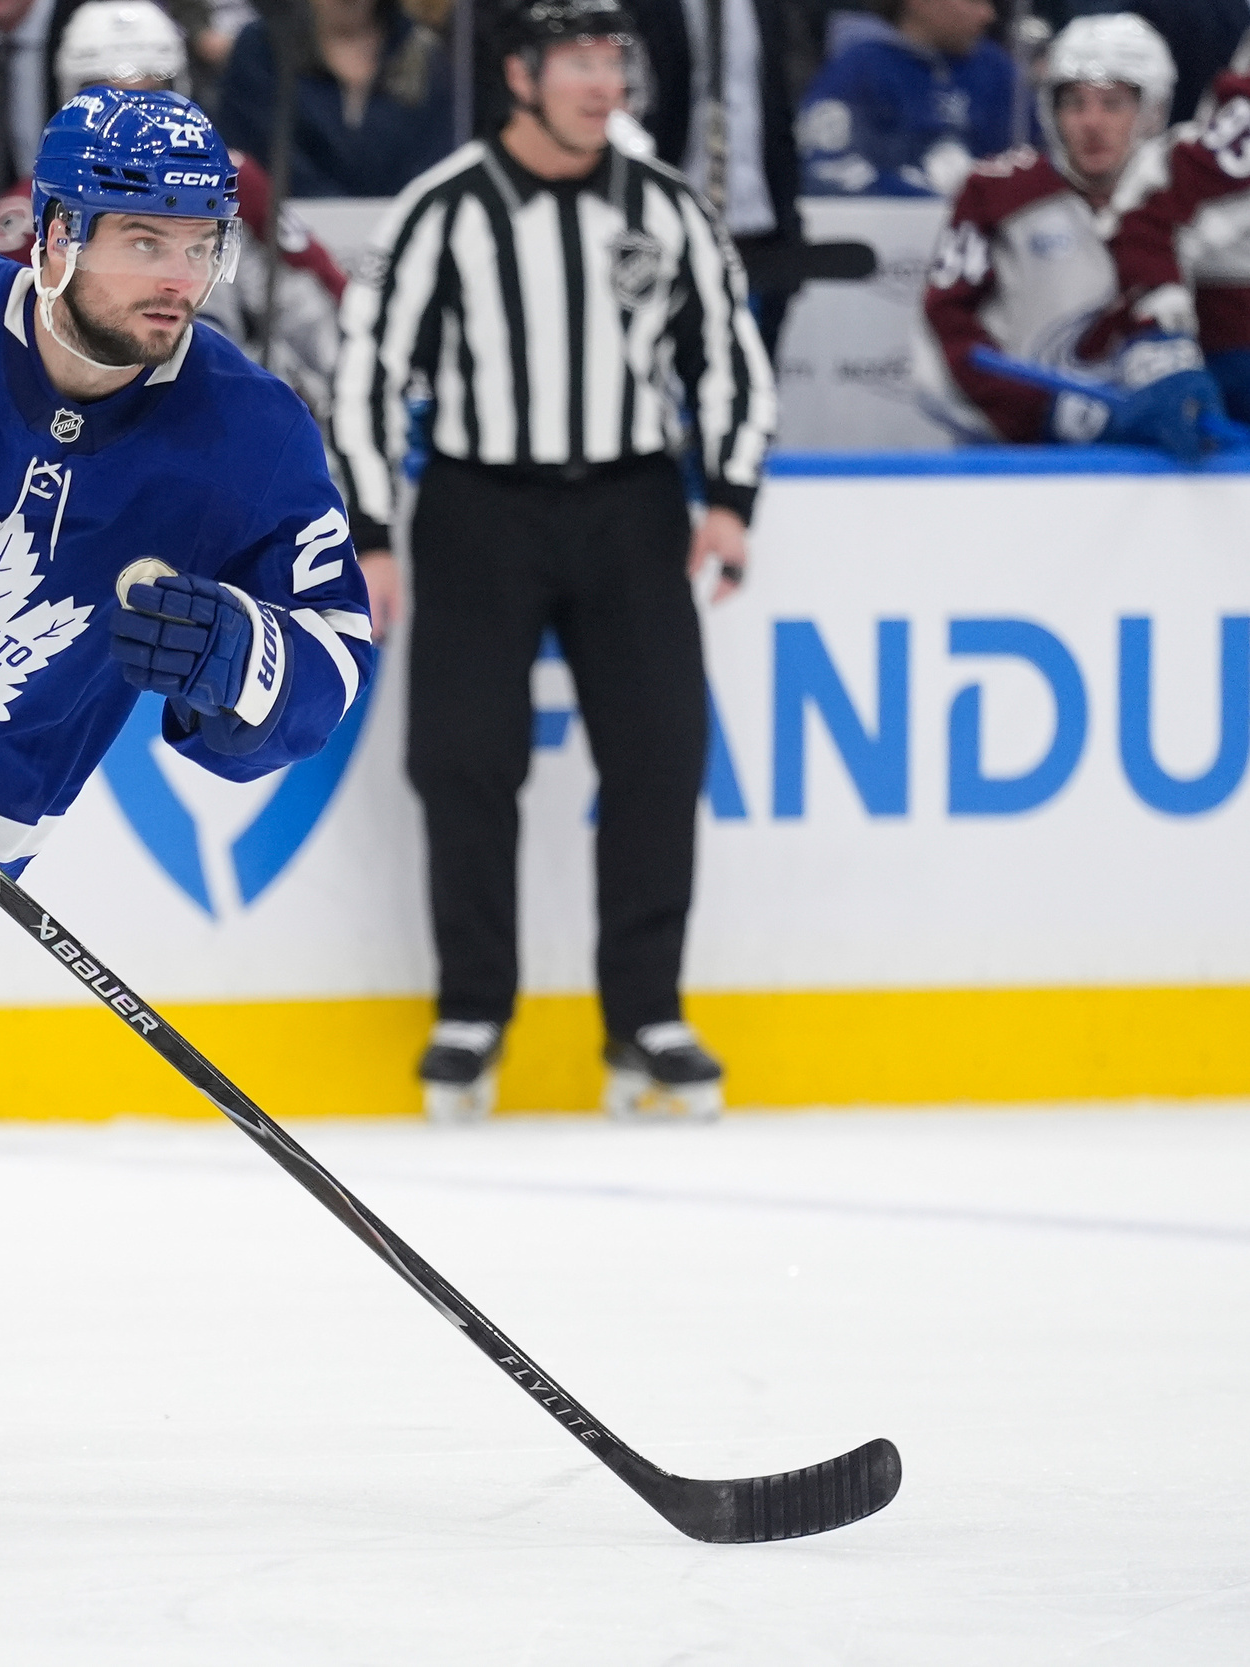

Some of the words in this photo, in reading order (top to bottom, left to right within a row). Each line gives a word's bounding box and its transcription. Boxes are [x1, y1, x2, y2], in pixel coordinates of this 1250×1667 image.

[162, 121, 205, 149] 24
[164, 171, 220, 187] CCM
[55, 421, 78, 434] NHL
[497, 1355, 601, 1441] FLYLITE
